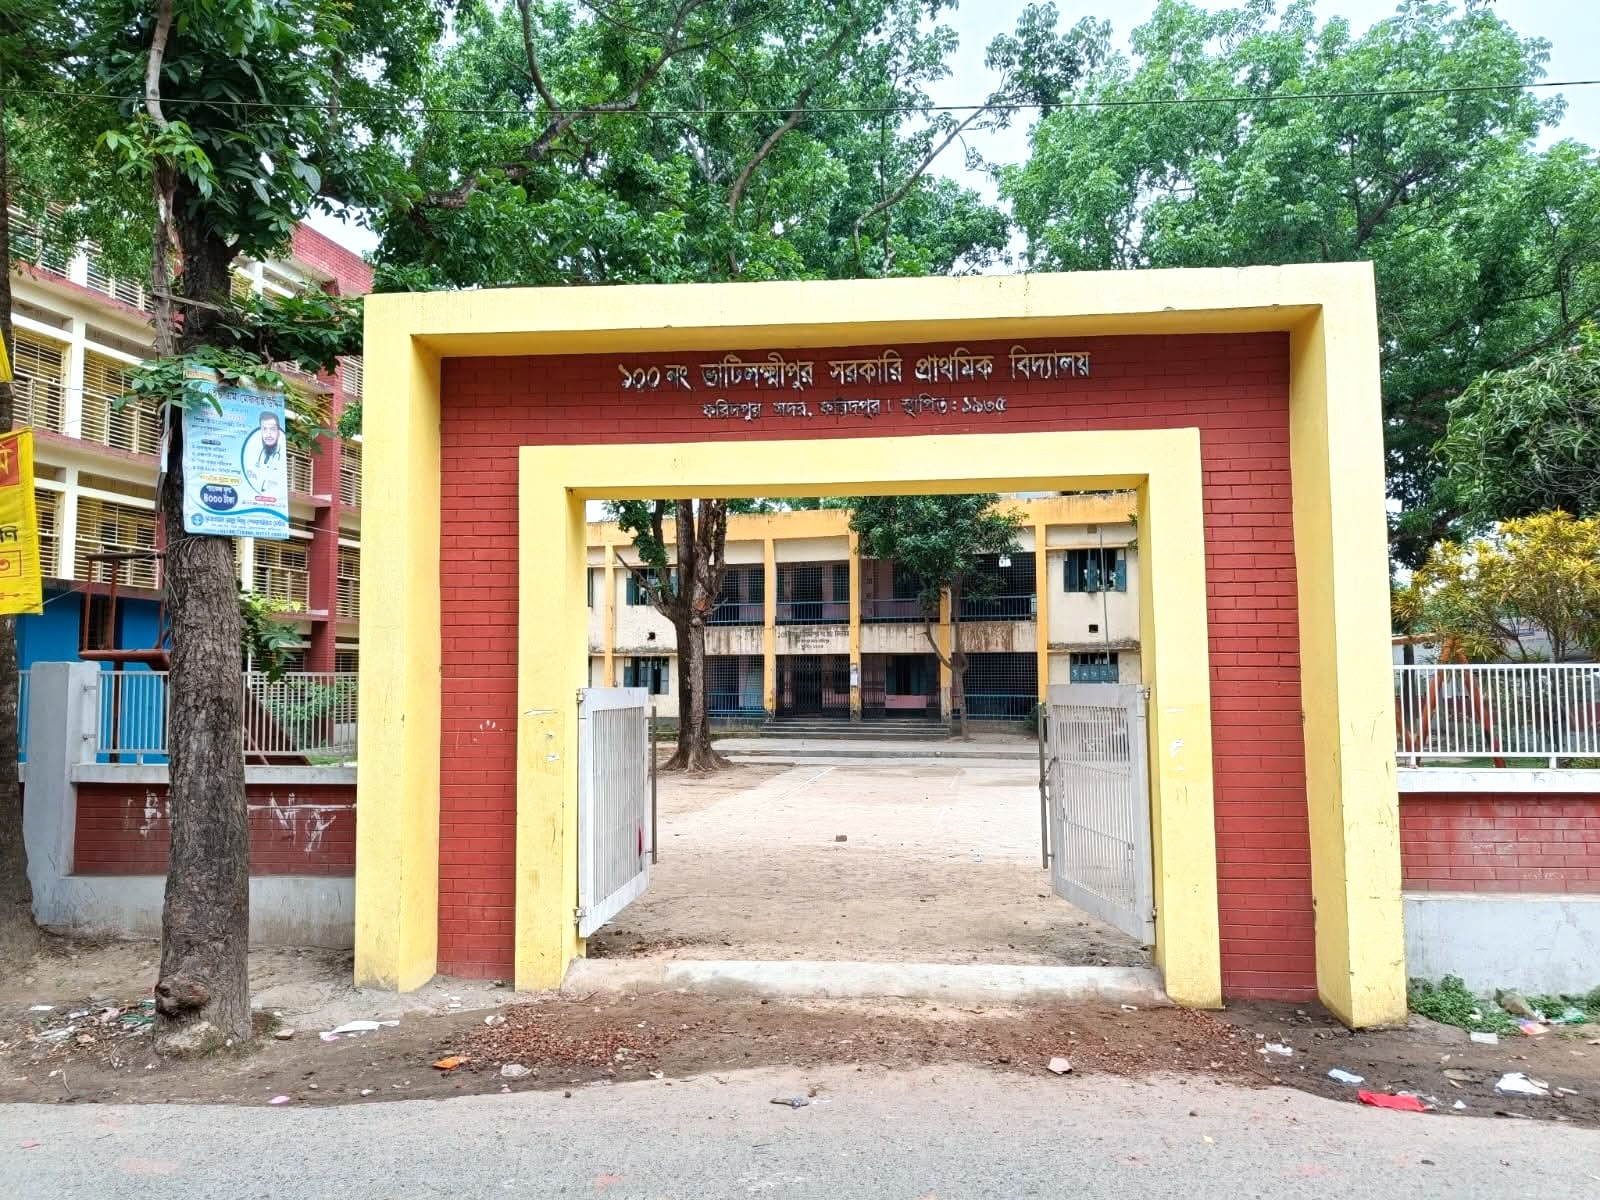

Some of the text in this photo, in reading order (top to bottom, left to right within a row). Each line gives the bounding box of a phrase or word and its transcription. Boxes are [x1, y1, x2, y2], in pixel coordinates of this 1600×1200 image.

[618, 363, 661, 391] ১০০
[665, 364, 695, 391] নং
[828, 349, 904, 385] সরকারি
[915, 347, 994, 385] প্রাথমিক
[1008, 345, 1092, 380] বিদ্যালয়
[702, 399, 762, 420] ফরিদপুর
